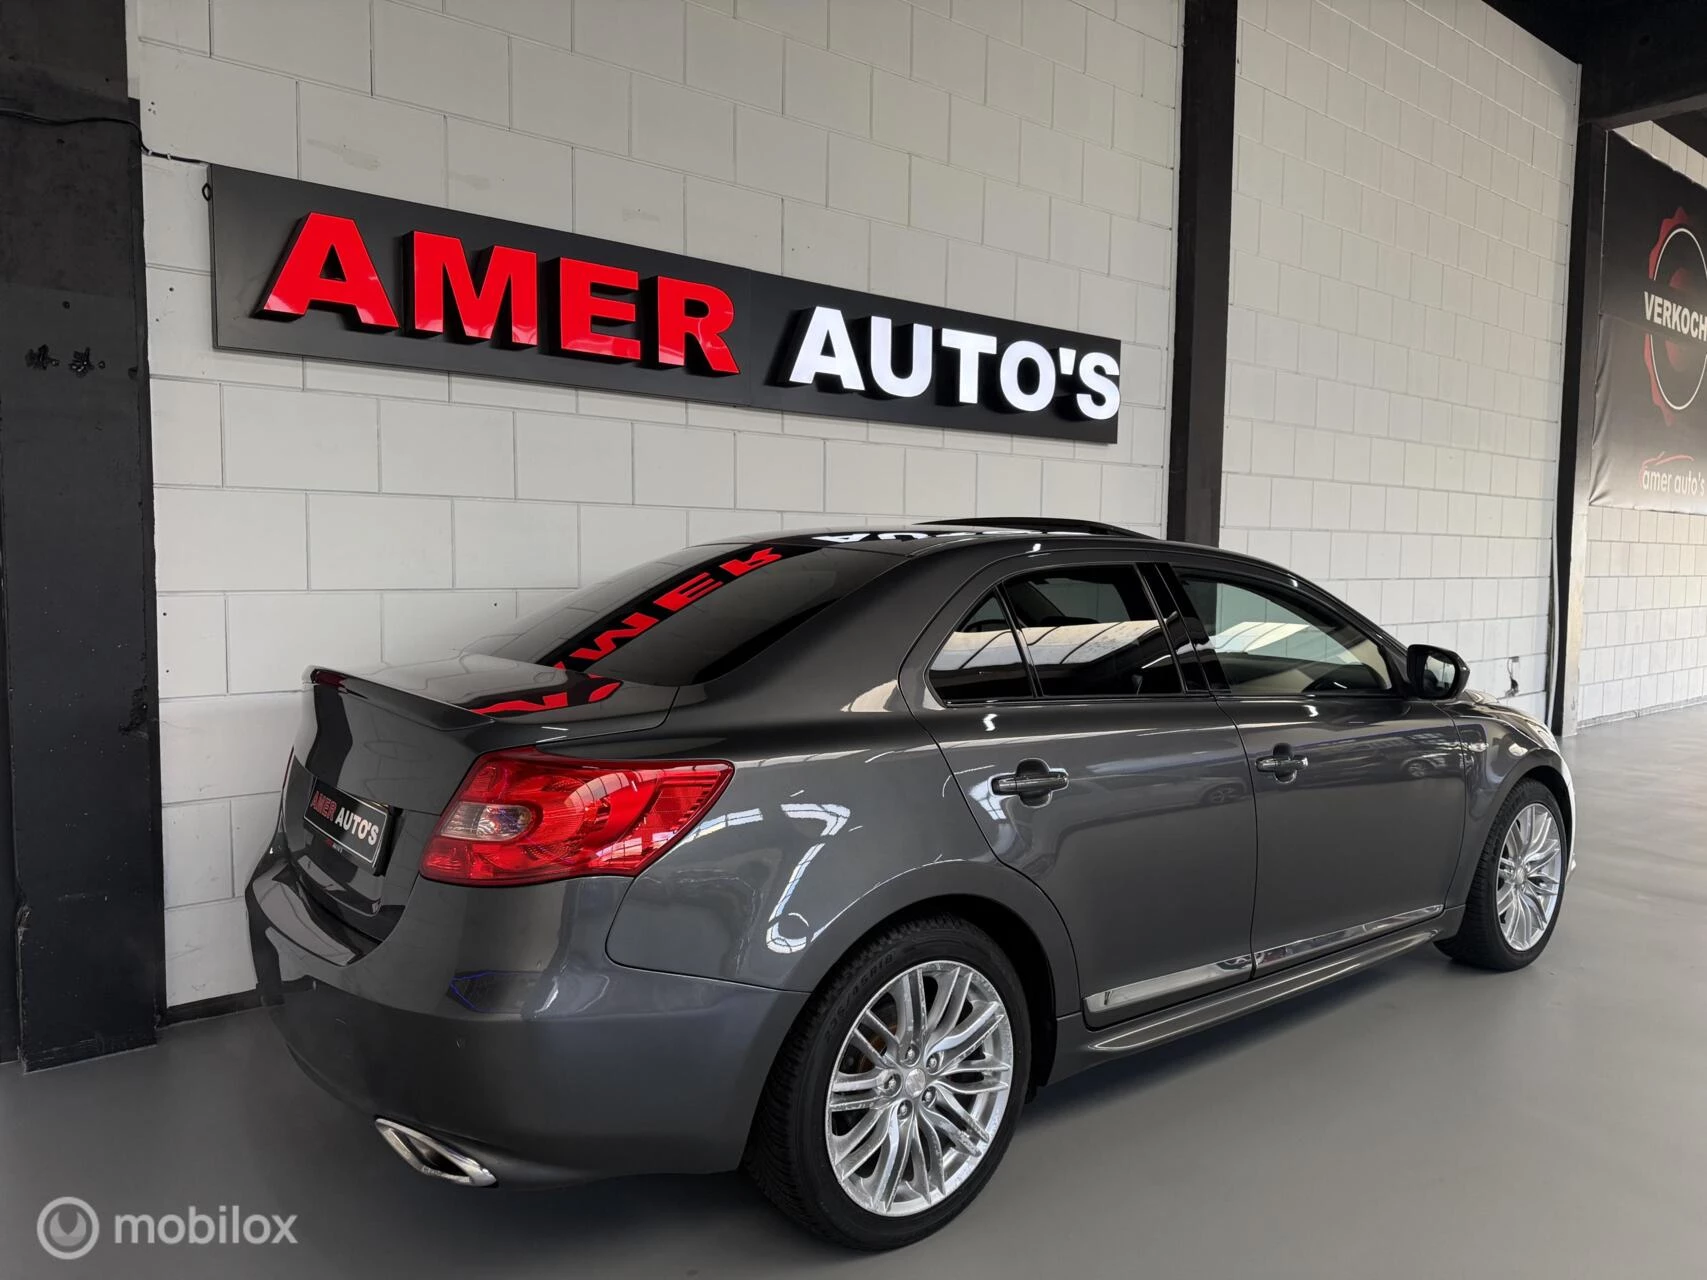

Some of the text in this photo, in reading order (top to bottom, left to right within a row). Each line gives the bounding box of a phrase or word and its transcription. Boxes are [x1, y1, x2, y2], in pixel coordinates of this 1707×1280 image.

[262, 211, 1121, 421] AMER AUTO'S
[1642, 470, 1705, 497] amer auto's
[310, 790, 337, 822] AMER
[334, 807, 380, 846] AUTO'S
